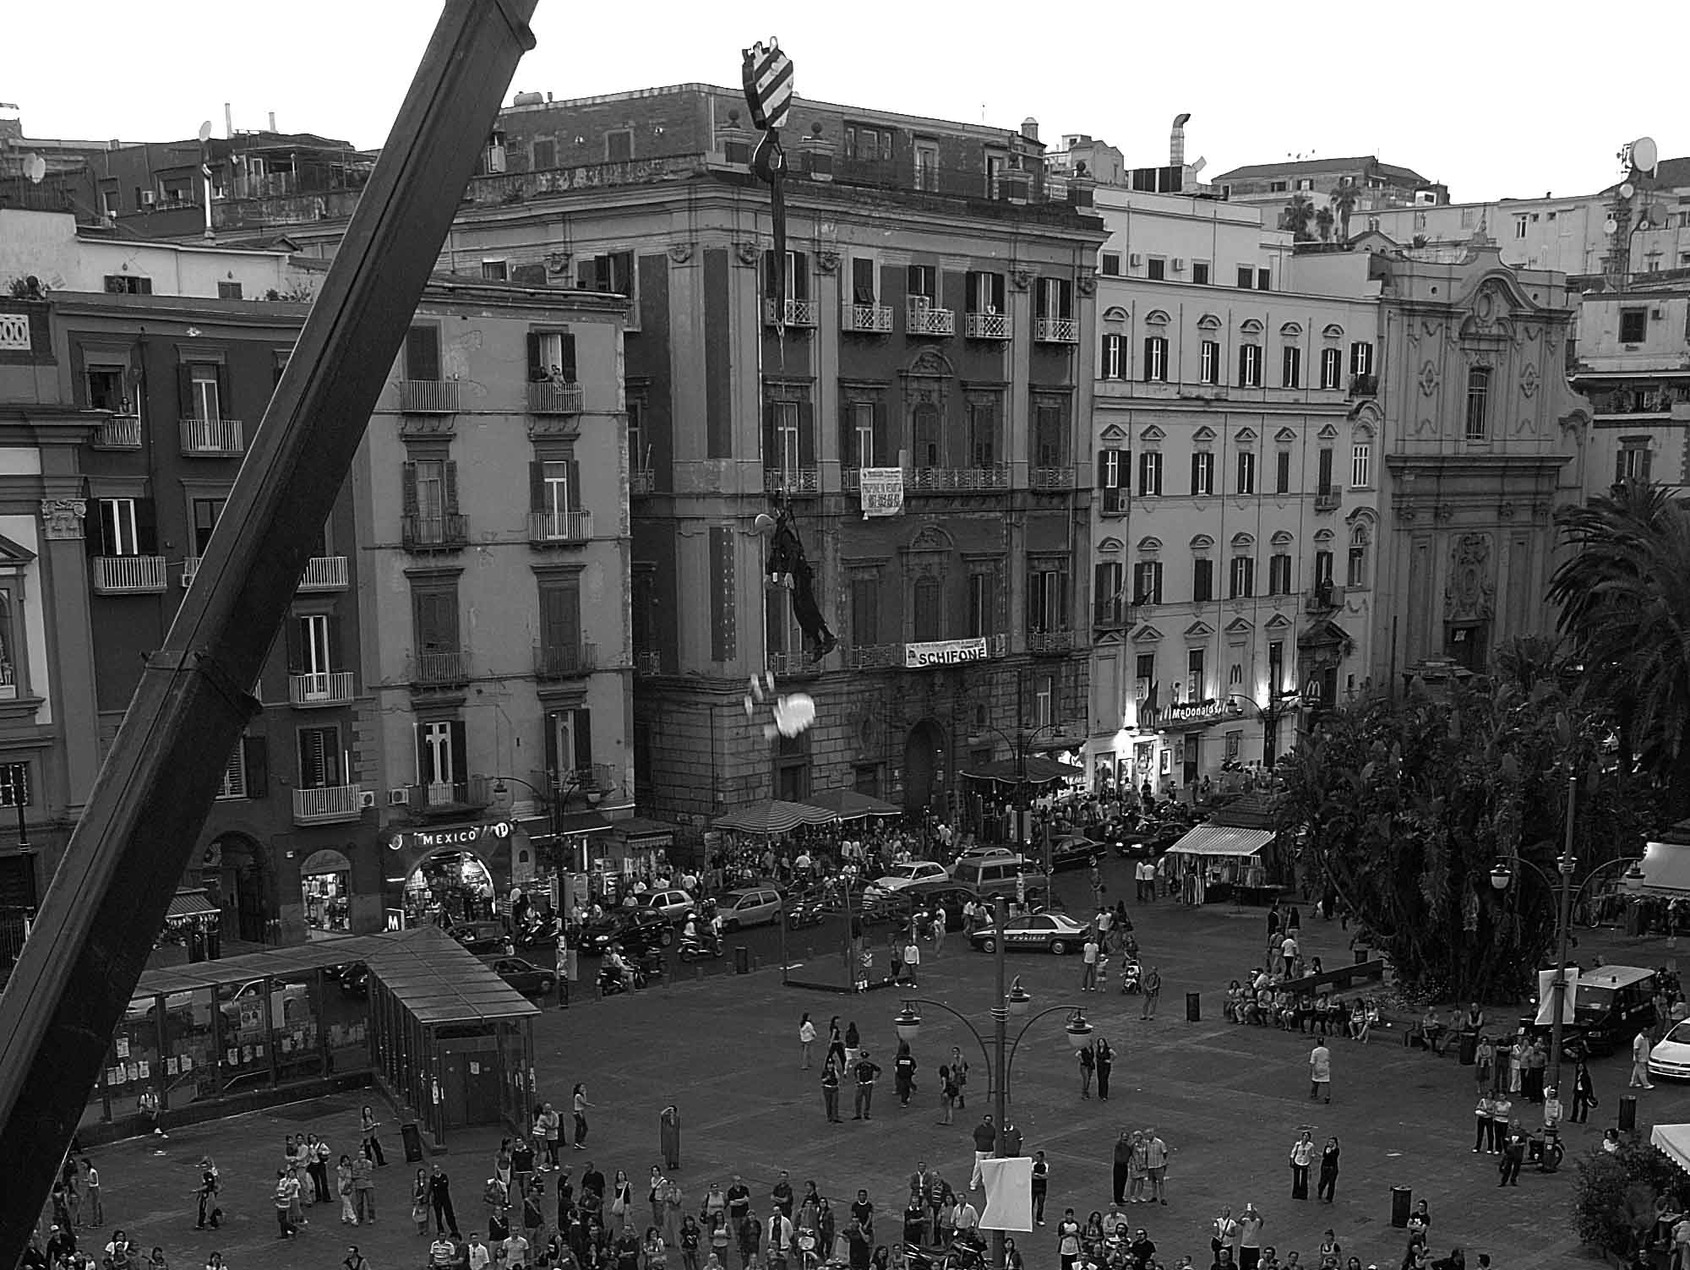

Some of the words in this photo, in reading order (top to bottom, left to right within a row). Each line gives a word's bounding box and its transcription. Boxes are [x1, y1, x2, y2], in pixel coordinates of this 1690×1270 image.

[918, 648, 985, 664] SCHIFONE
[423, 831, 476, 845] MEXICO
[388, 915, 399, 930] M
